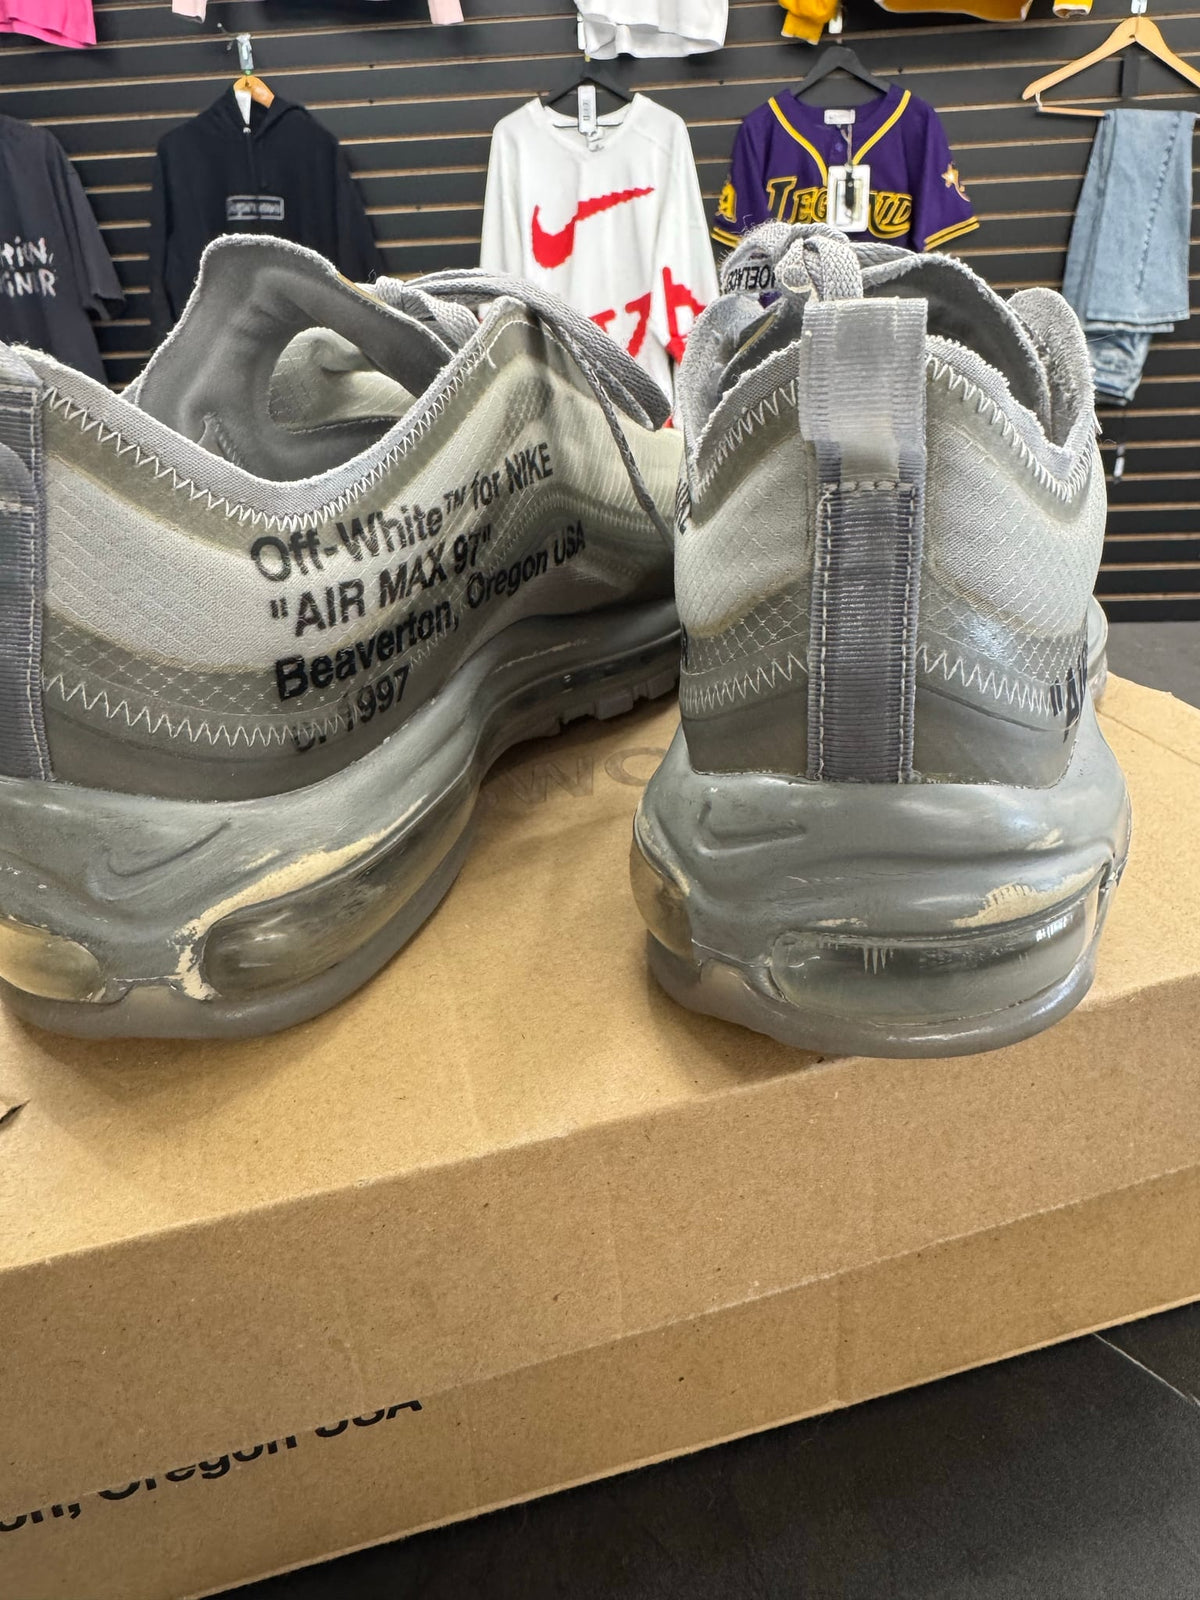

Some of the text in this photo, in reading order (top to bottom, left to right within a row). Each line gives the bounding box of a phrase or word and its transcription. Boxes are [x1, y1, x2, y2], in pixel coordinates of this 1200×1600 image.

[470, 470, 500, 511] for
[505, 442, 554, 494] NIKE
[270, 524, 491, 637] "AIR MAX 97"
[275, 520, 587, 702] Beaverton, Oregon USA
